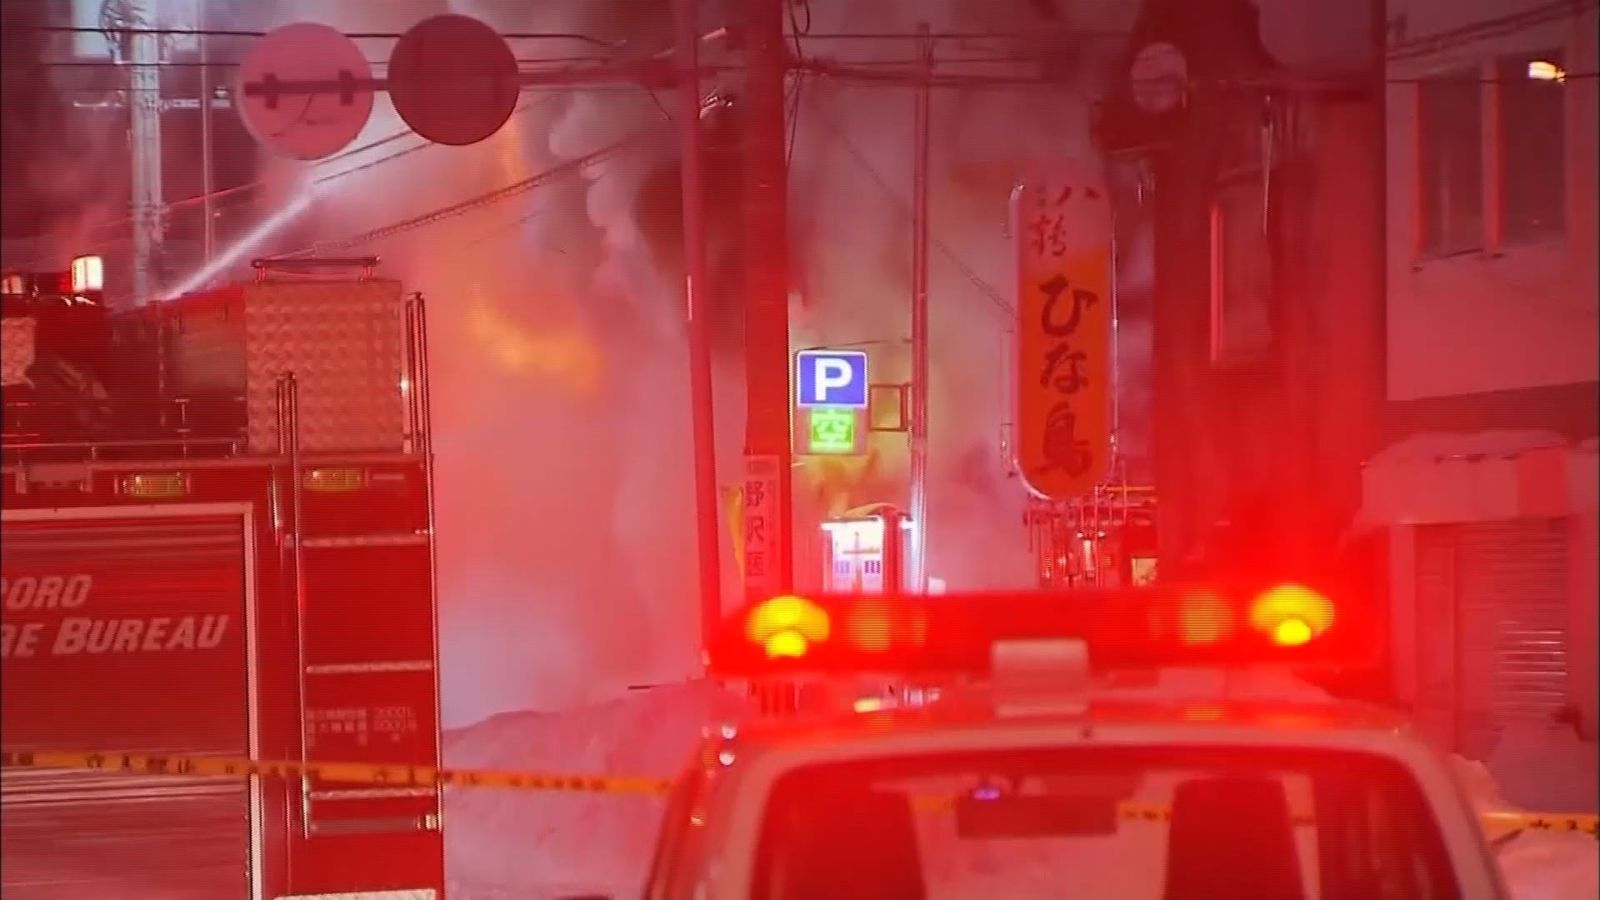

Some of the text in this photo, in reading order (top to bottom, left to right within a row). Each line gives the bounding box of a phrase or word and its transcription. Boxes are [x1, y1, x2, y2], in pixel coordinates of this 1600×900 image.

[815, 358, 852, 400] P
[811, 407, 853, 450] 空
[2, 574, 92, 610] ORO
[52, 614, 229, 654] BUREAU
